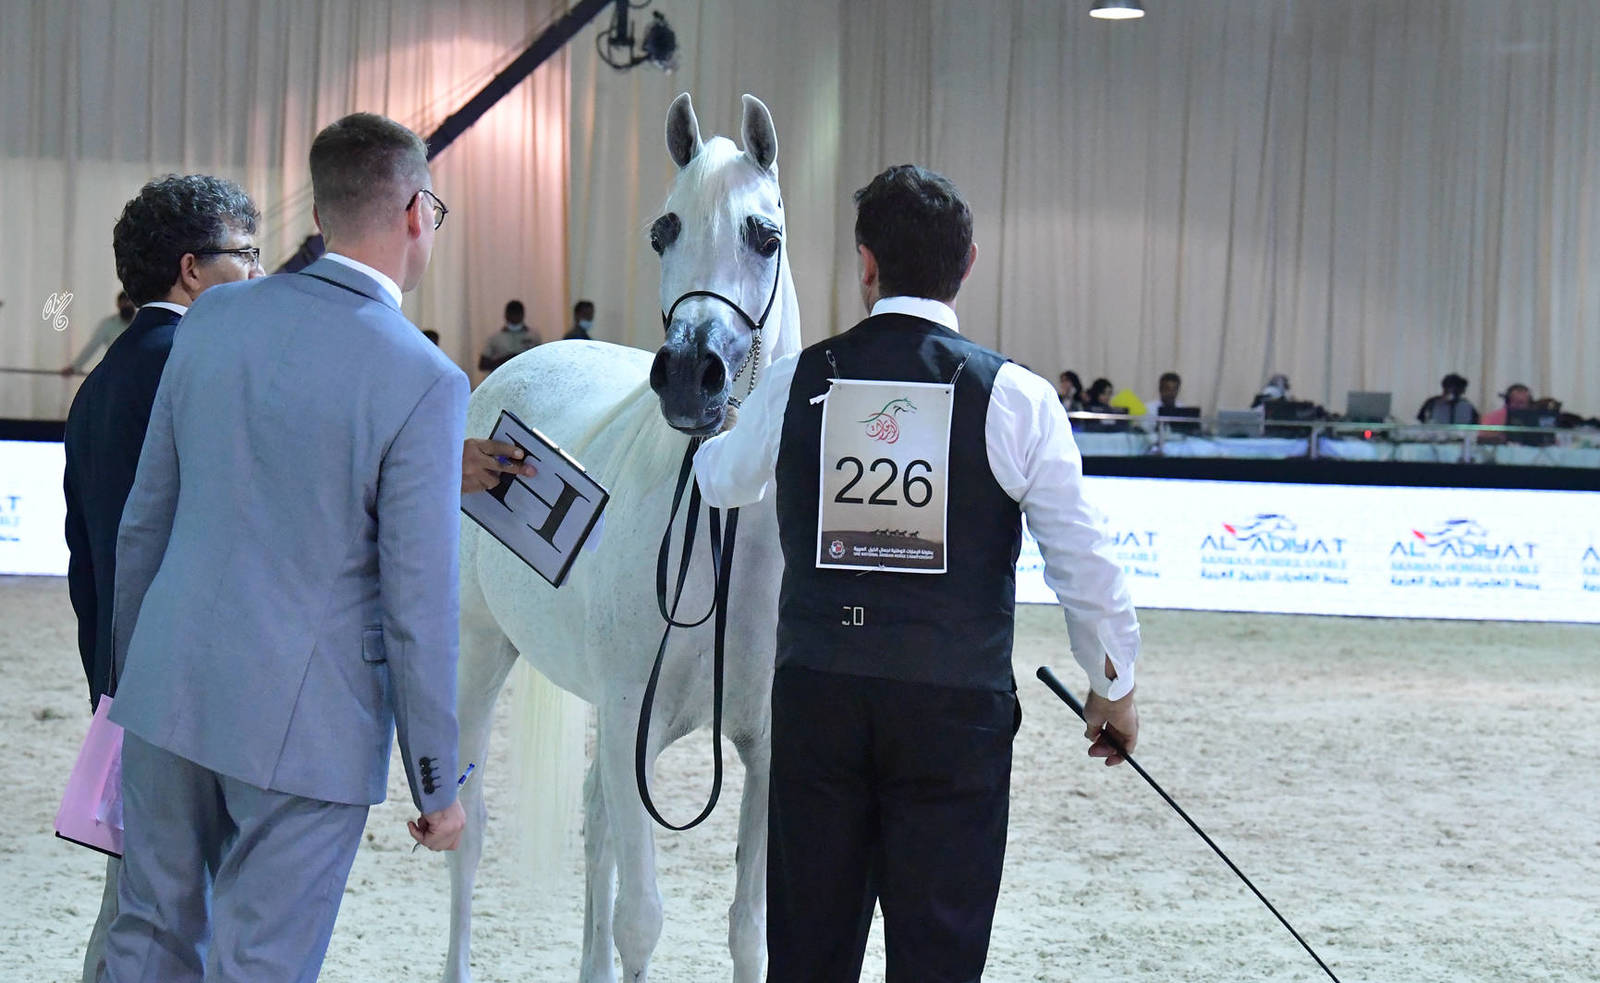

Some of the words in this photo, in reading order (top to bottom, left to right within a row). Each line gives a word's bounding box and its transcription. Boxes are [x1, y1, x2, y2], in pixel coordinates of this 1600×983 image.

[834, 456, 933, 508] 226
[1200, 534, 1237, 551] AL
[1390, 541, 1427, 558] AL
